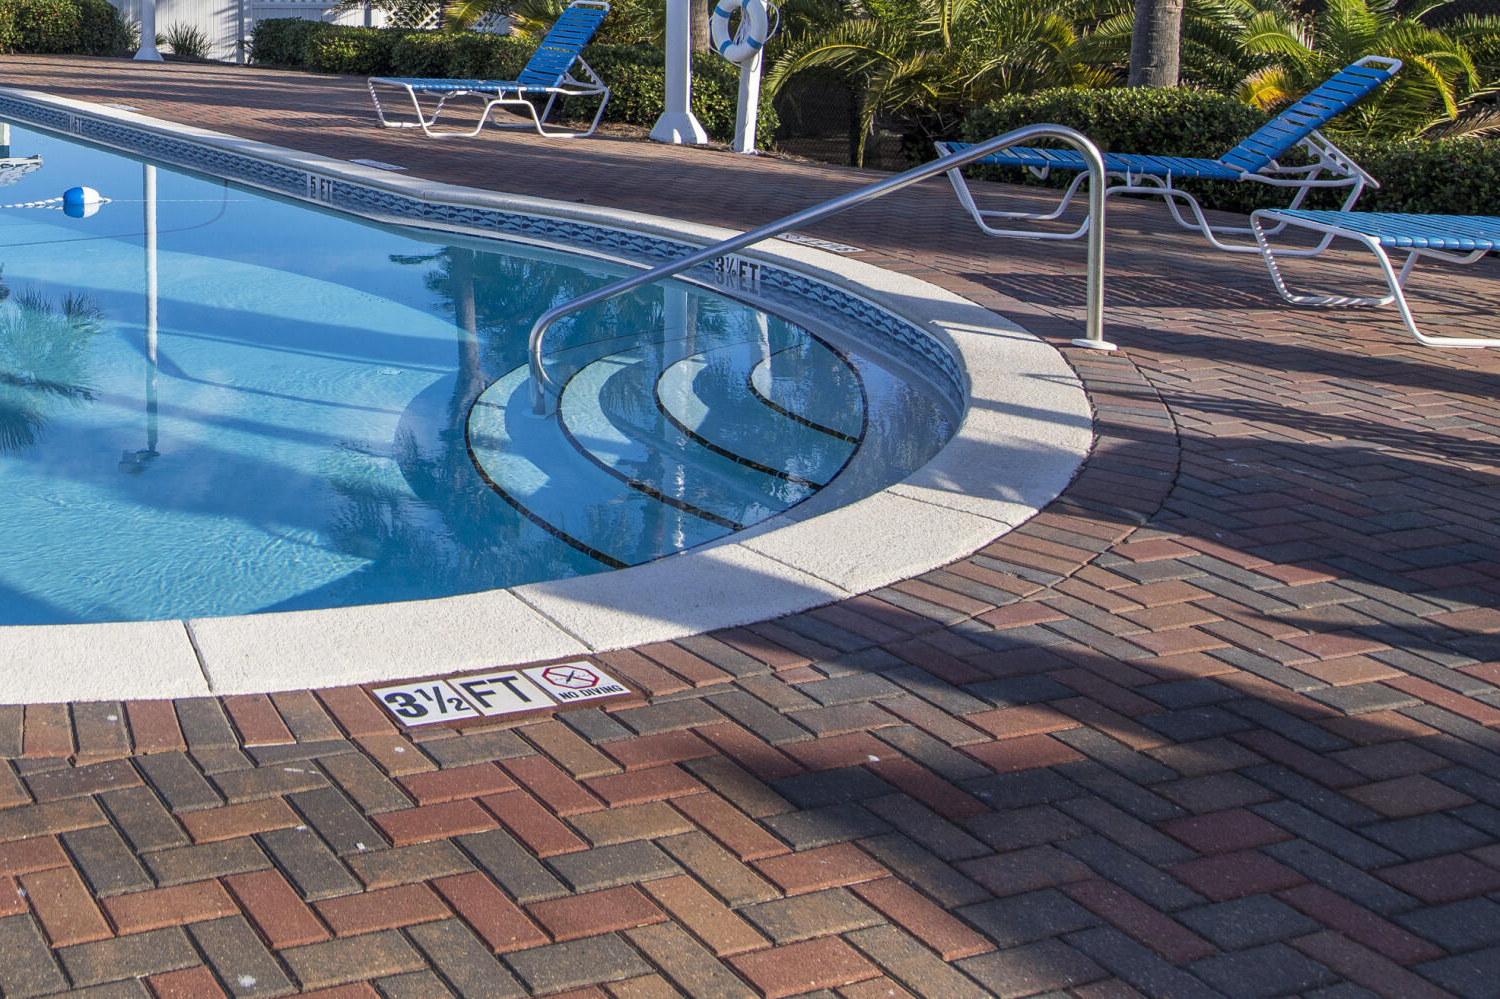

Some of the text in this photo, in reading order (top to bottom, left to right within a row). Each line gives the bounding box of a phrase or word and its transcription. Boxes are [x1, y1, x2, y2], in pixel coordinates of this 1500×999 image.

[739, 260, 759, 281] FT
[458, 675, 534, 709] FT
[558, 684, 624, 700] NO DIVING
